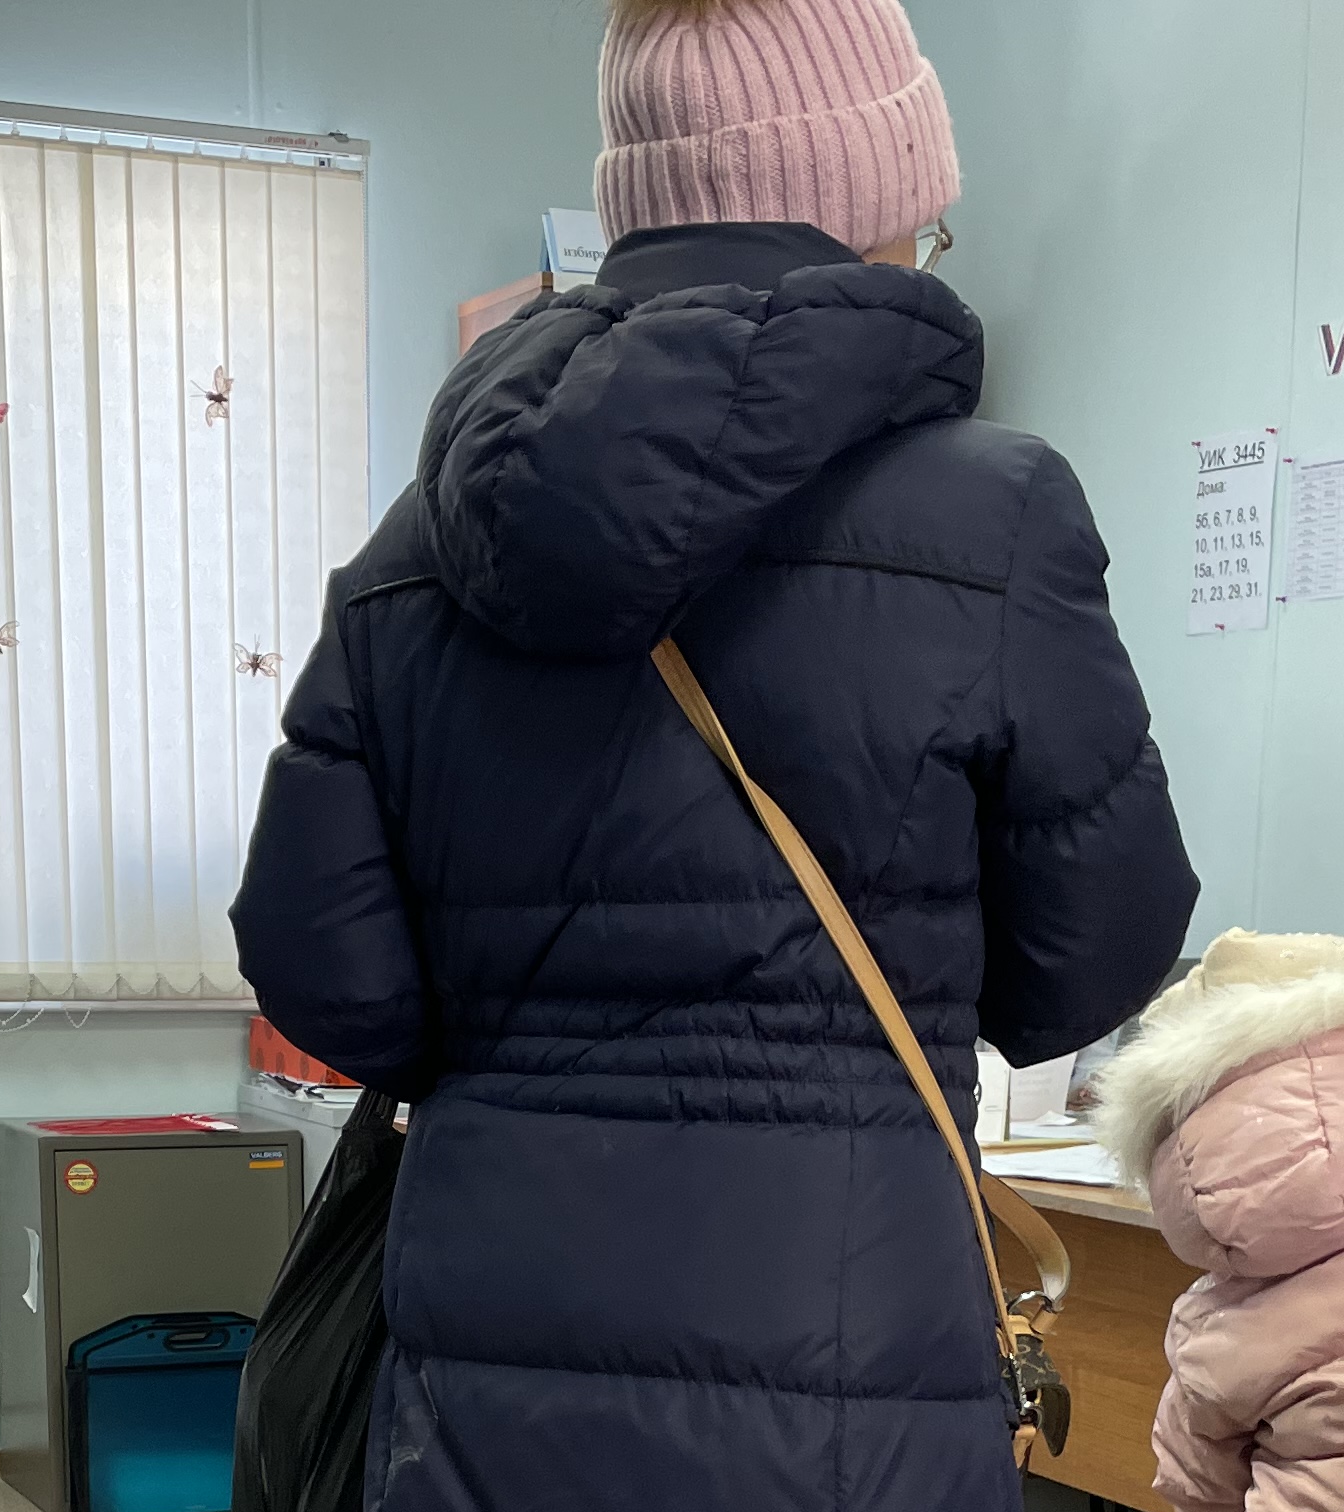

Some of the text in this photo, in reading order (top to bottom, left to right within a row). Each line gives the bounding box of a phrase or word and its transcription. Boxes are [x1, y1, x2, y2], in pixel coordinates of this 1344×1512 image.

[1199, 441, 1266, 470] УИК 3445
[1196, 481, 1227, 499] Дома:
[1249, 530, 1264, 547] 15,
